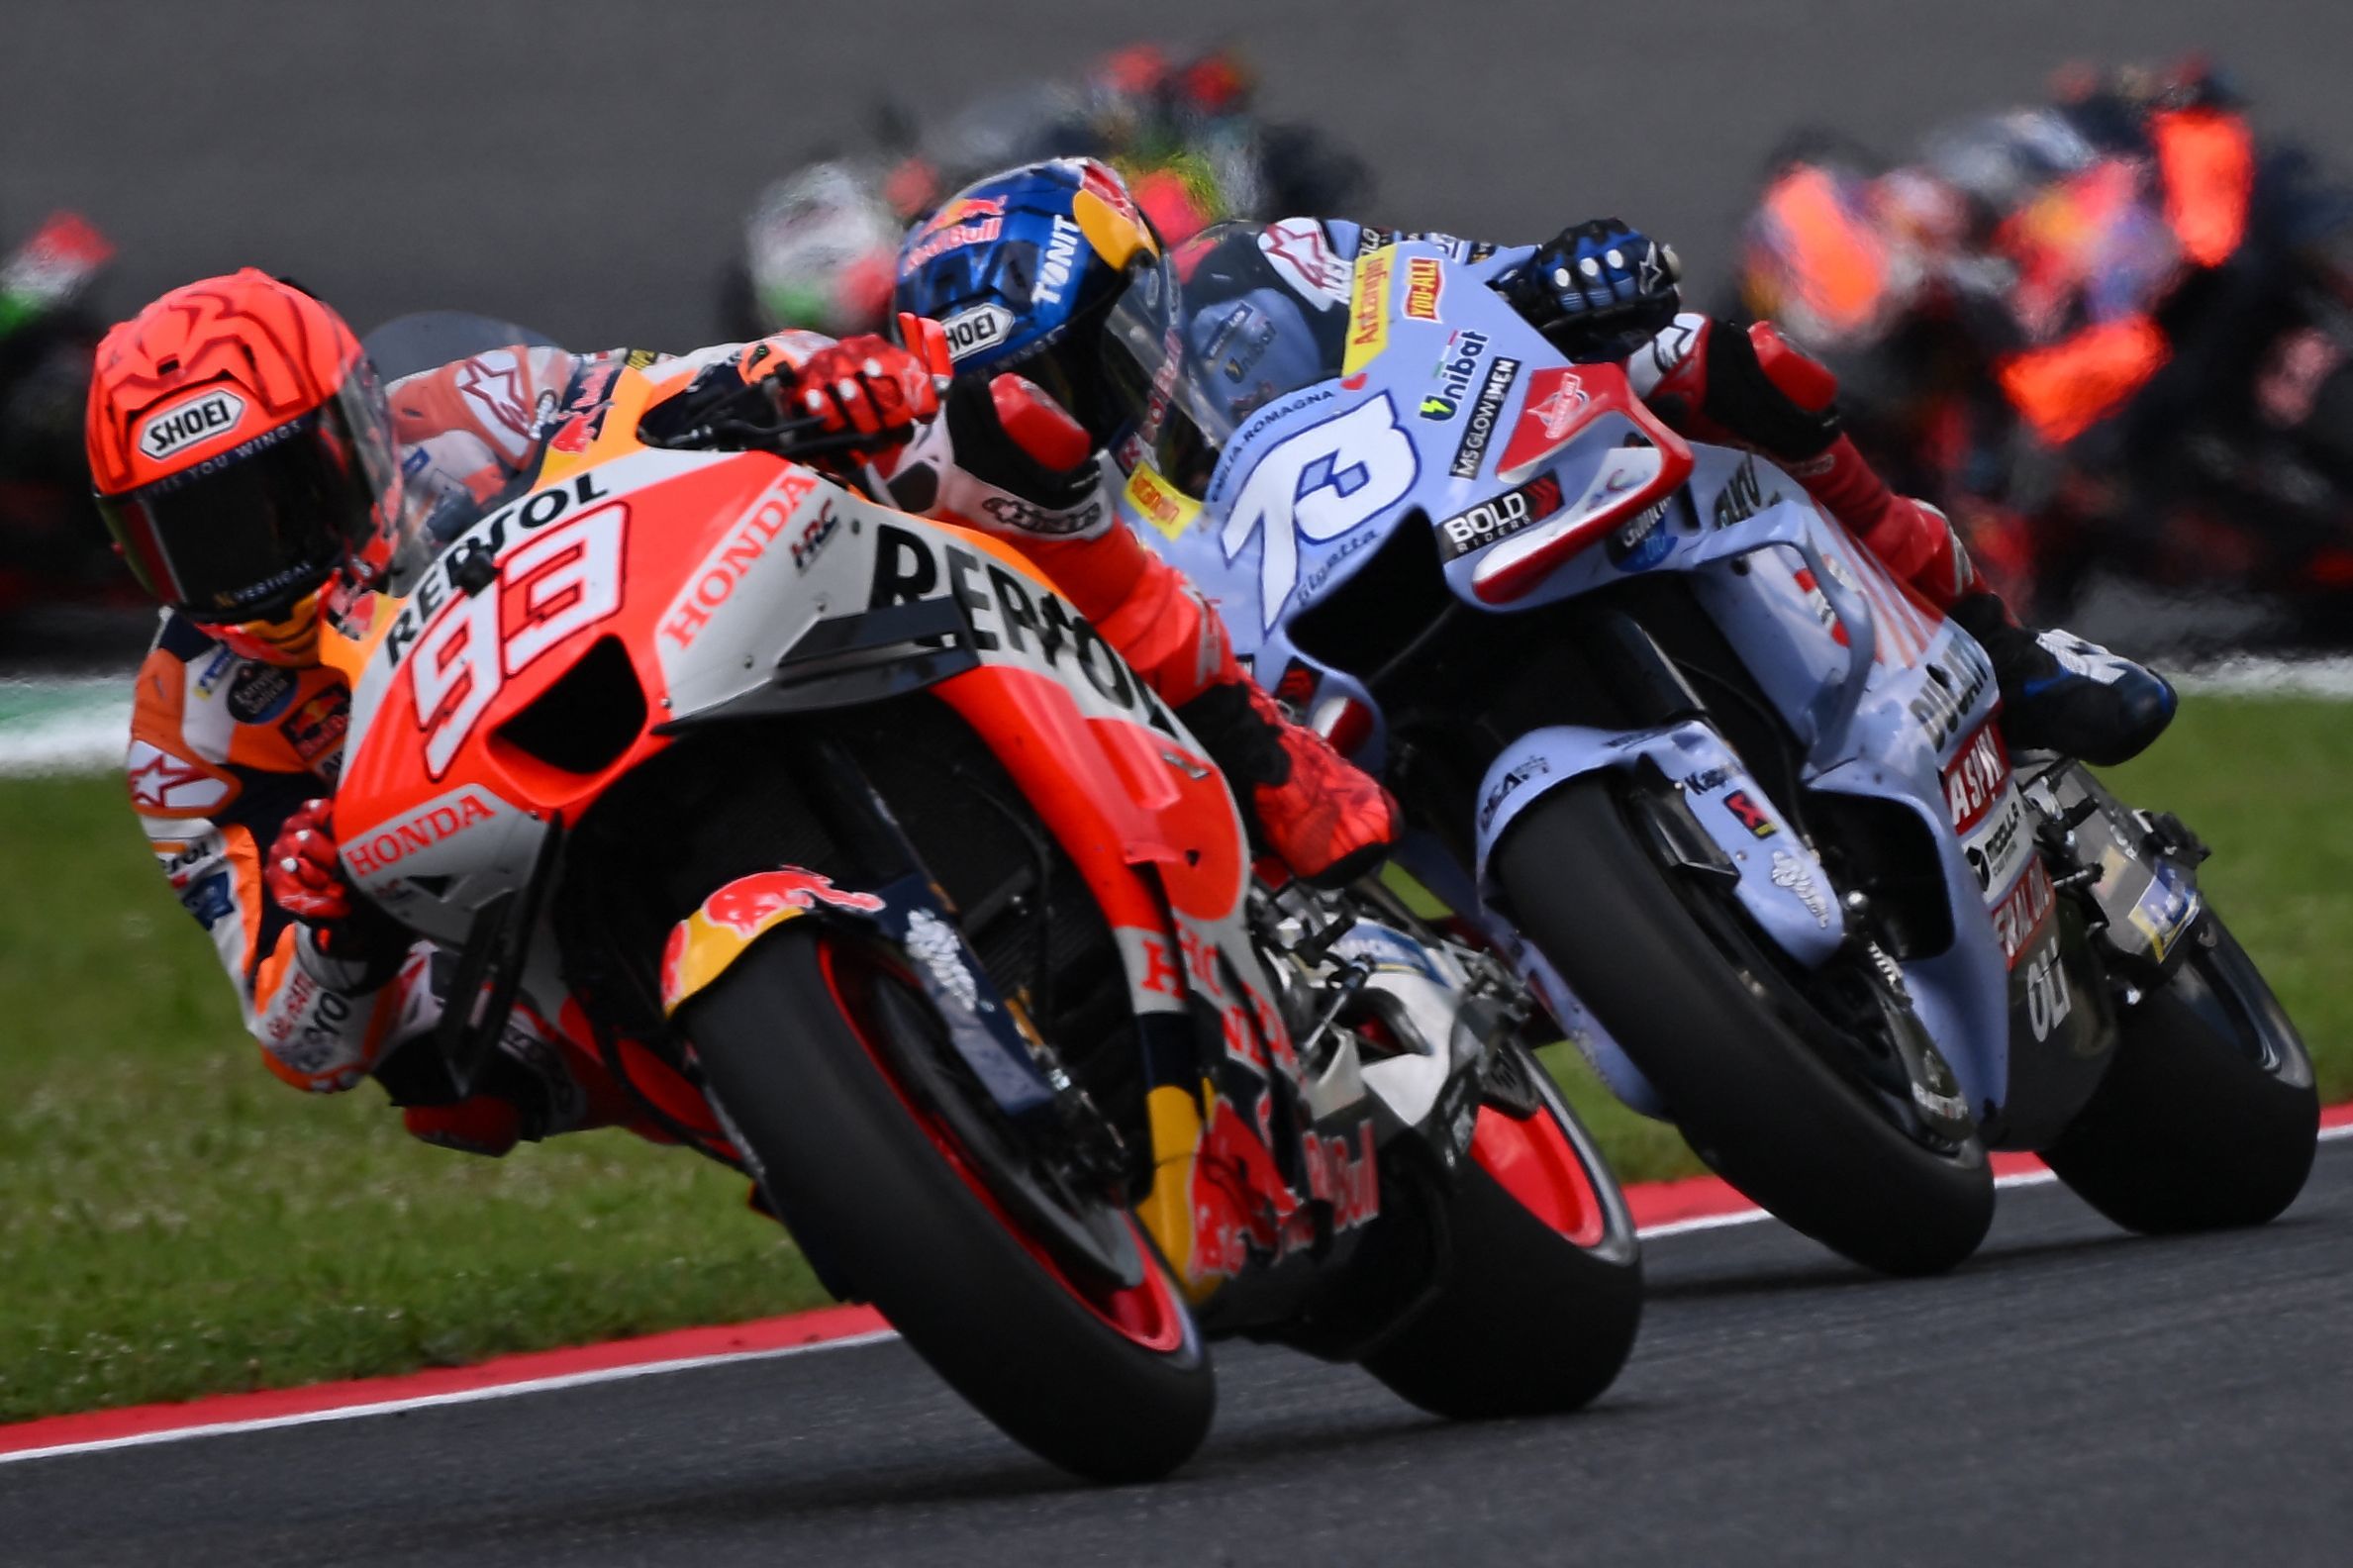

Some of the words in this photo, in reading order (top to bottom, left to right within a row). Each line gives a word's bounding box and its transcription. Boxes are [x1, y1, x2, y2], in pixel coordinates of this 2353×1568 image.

[943, 313, 996, 350] HOEI
[1420, 330, 1489, 423] Unibat
[149, 396, 231, 451] SHOEI
[1470, 399, 1499, 447] GLOW
[1443, 491, 1527, 544] BOLD
[1457, 515, 1532, 553] RIDERS
[663, 472, 818, 650] HONDA
[412, 501, 631, 782] 93
[343, 792, 495, 878] HONDA
